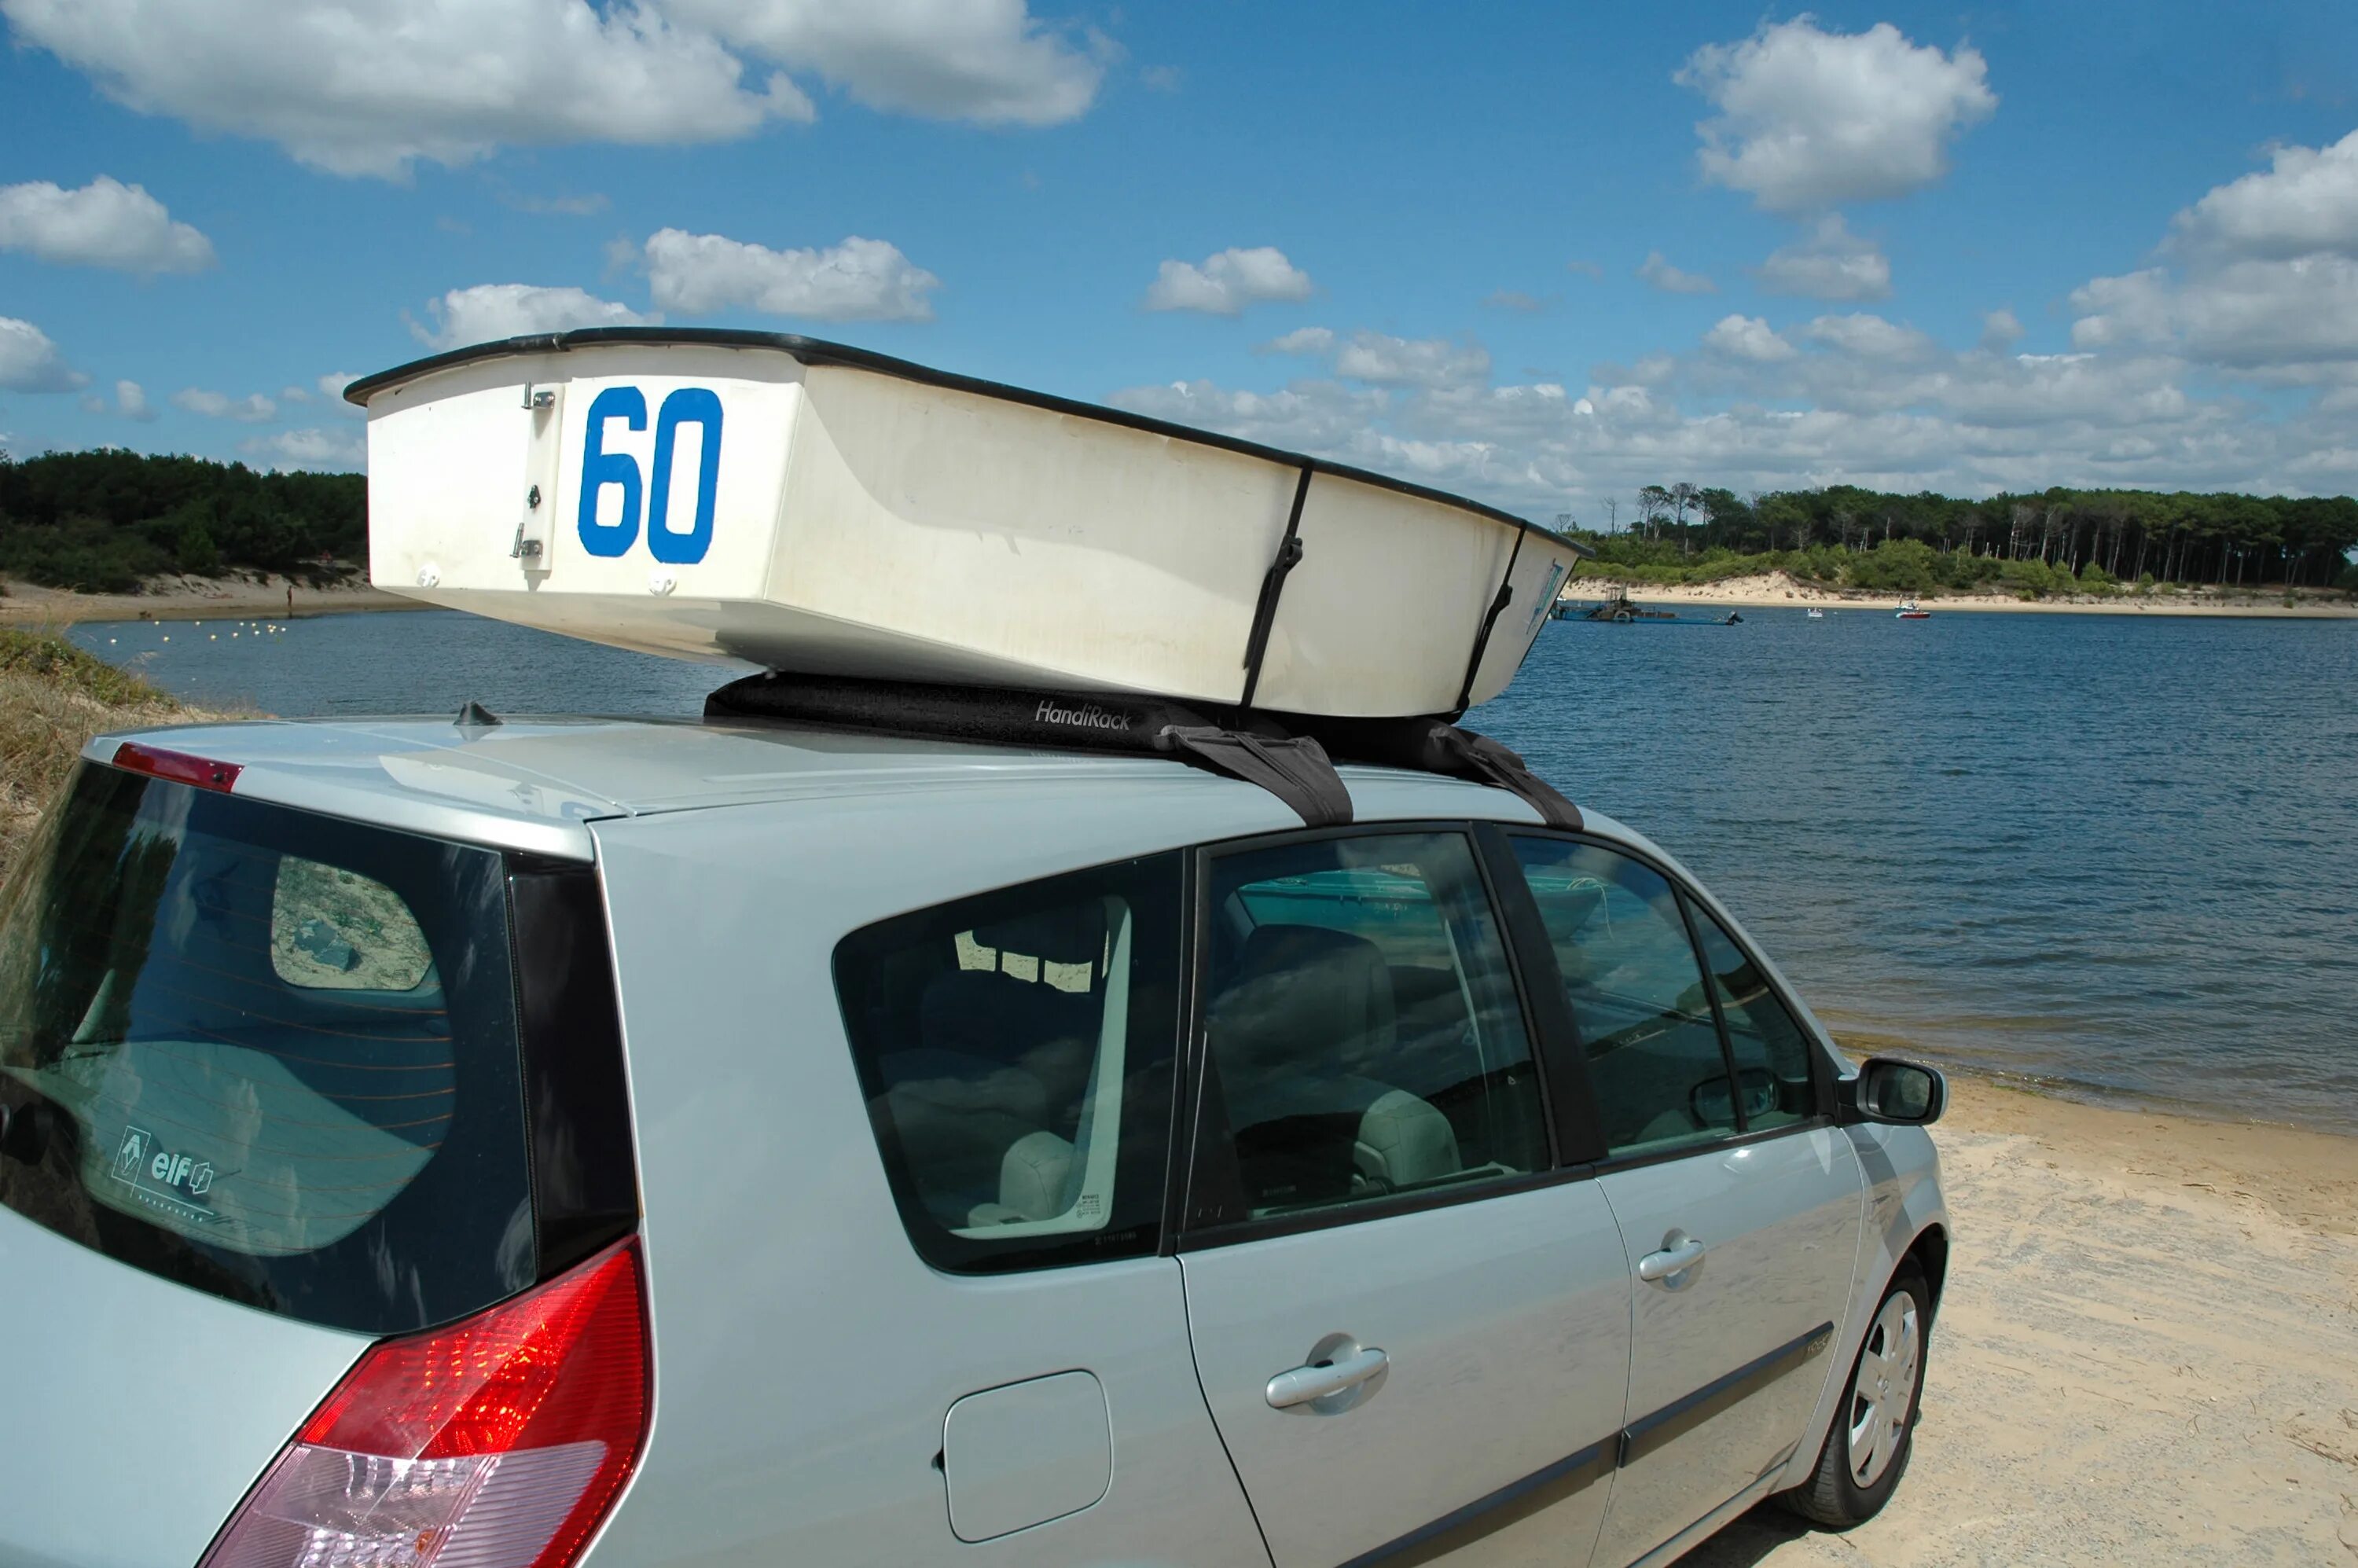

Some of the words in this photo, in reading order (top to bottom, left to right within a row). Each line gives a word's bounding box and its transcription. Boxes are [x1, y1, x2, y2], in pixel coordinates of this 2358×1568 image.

[578, 386, 723, 564] 60
[1035, 700, 1131, 730] HandiRack
[152, 1152, 192, 1186] elf
